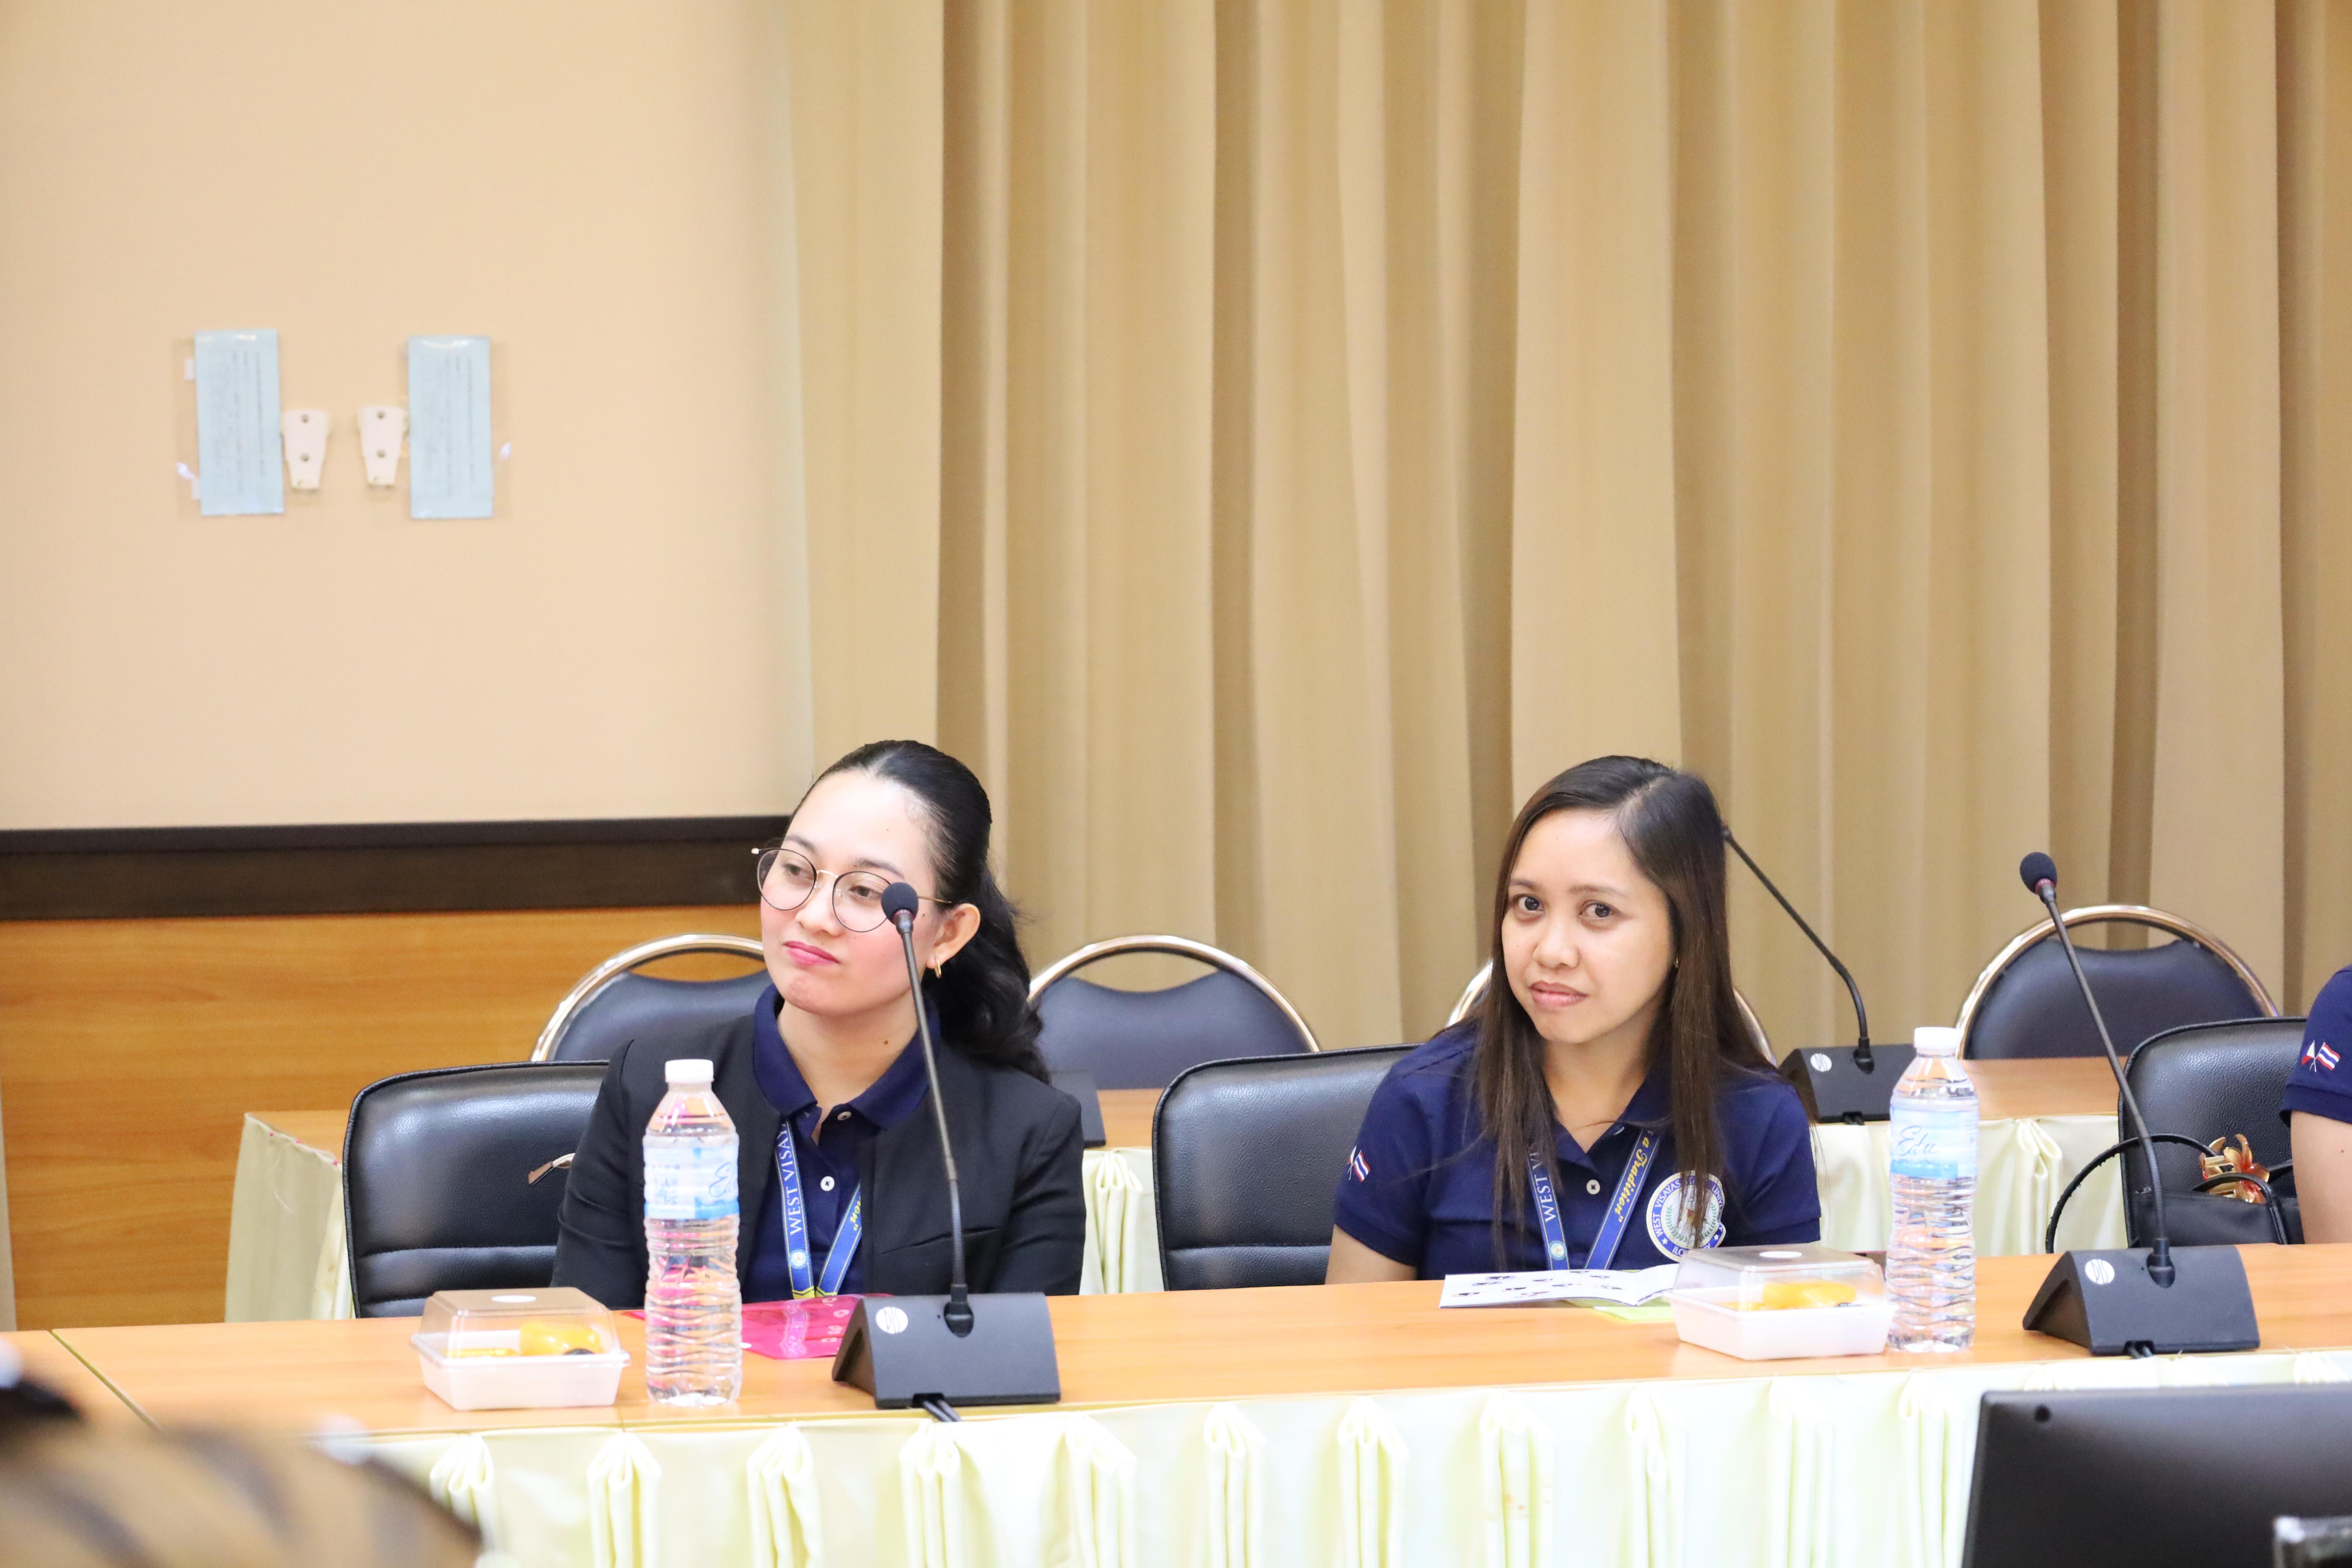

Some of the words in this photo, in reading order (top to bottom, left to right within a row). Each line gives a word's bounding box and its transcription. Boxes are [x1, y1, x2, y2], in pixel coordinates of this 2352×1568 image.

[776, 1124, 795, 1181] VISAY
[1642, 1136, 1650, 1148] a
[786, 1186, 802, 1235] WEST
[1534, 1174, 1556, 1222] WEST
[1654, 1179, 1681, 1207] VISAYAS
[1652, 1212, 1664, 1237] WEST
